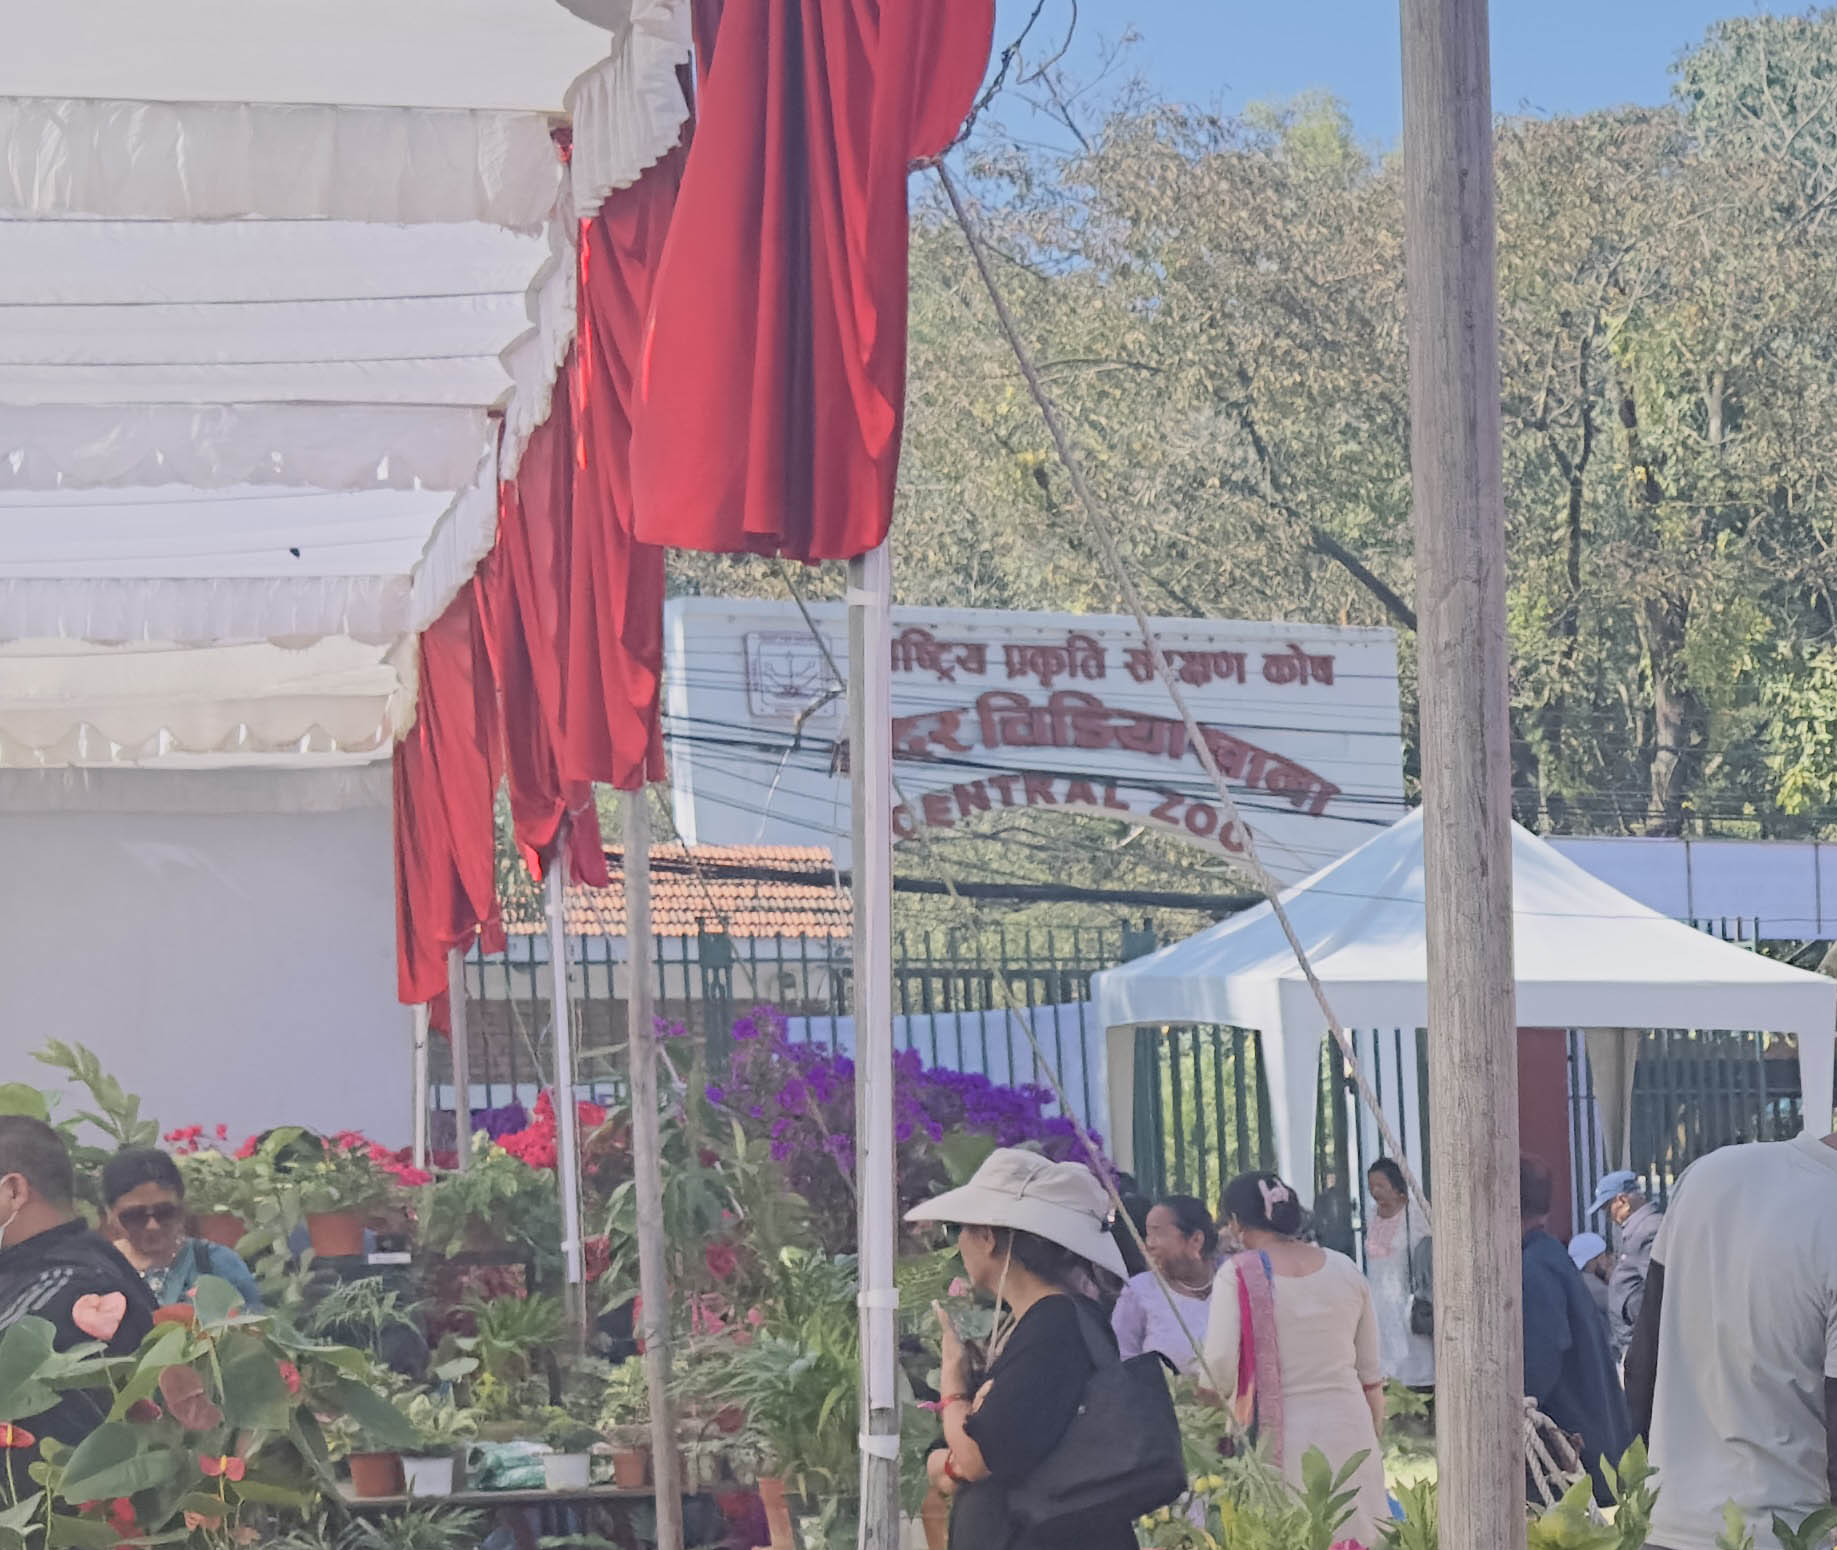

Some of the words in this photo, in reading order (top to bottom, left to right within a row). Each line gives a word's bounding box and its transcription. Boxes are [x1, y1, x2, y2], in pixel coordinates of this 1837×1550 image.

[891, 627, 987, 682] ाष्ट्रिय
[1003, 634, 1107, 687] प्रकृति
[1262, 643, 1335, 685] कोष
[892, 772, 1130, 840] CENTRAL
